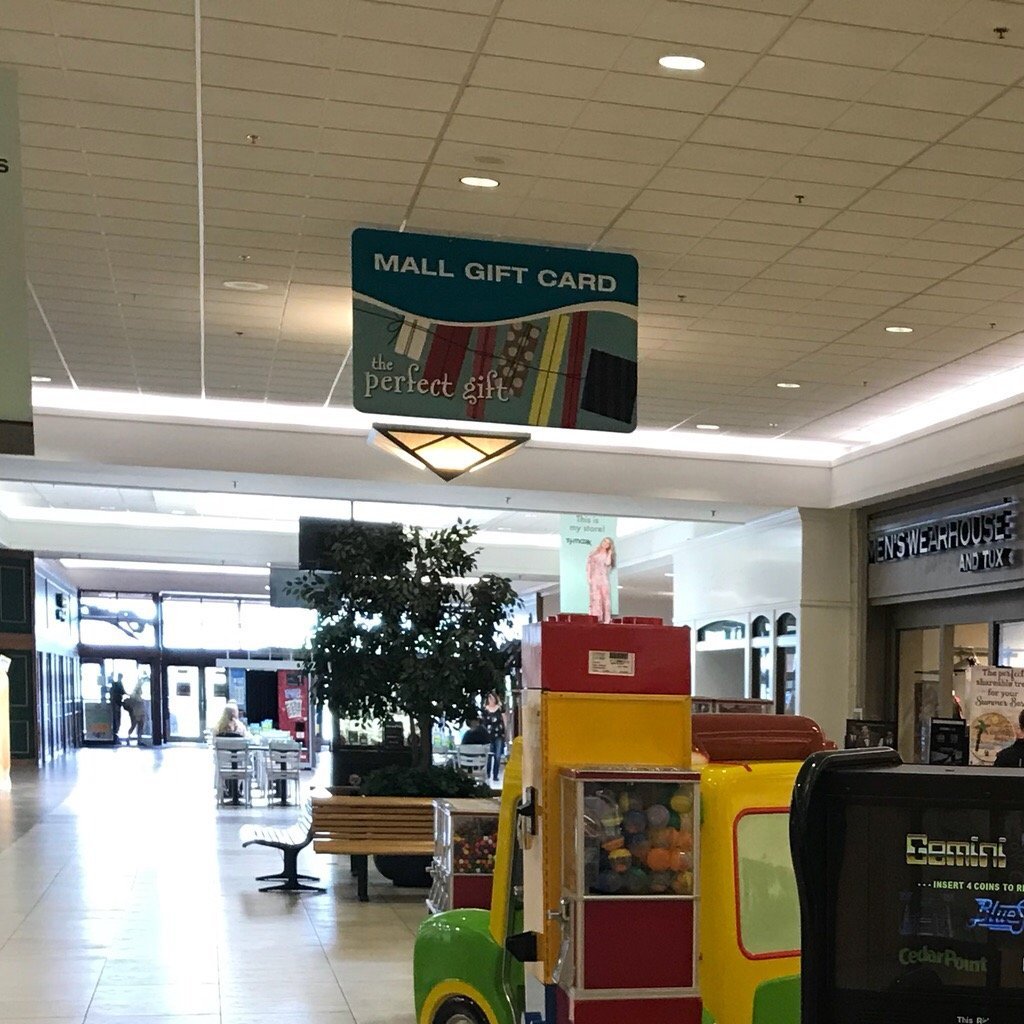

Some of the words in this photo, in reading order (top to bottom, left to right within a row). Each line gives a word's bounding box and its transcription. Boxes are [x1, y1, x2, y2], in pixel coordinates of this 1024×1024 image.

[374, 253, 455, 278] MALL
[465, 262, 529, 285] GIFT
[537, 269, 618, 293] CARD
[371, 354, 393, 371] the
[364, 364, 454, 398] perfect
[462, 370, 509, 405] gift
[905, 514, 1006, 556] WEARHOUSE
[959, 552, 979, 571] AND
[982, 548, 1004, 568] TUX
[982, 668, 997, 677] The
[998, 668, 1024, 681] perfect
[987, 688, 998, 696] for
[1001, 690, 1018, 698] your
[906, 833, 1007, 869] Gemini
[933, 881, 964, 890] INSERT
[966, 882, 972, 890] 4
[973, 882, 1000, 892] COINS
[1003, 883, 1014, 892] TO
[957, 1015, 973, 1024] This
